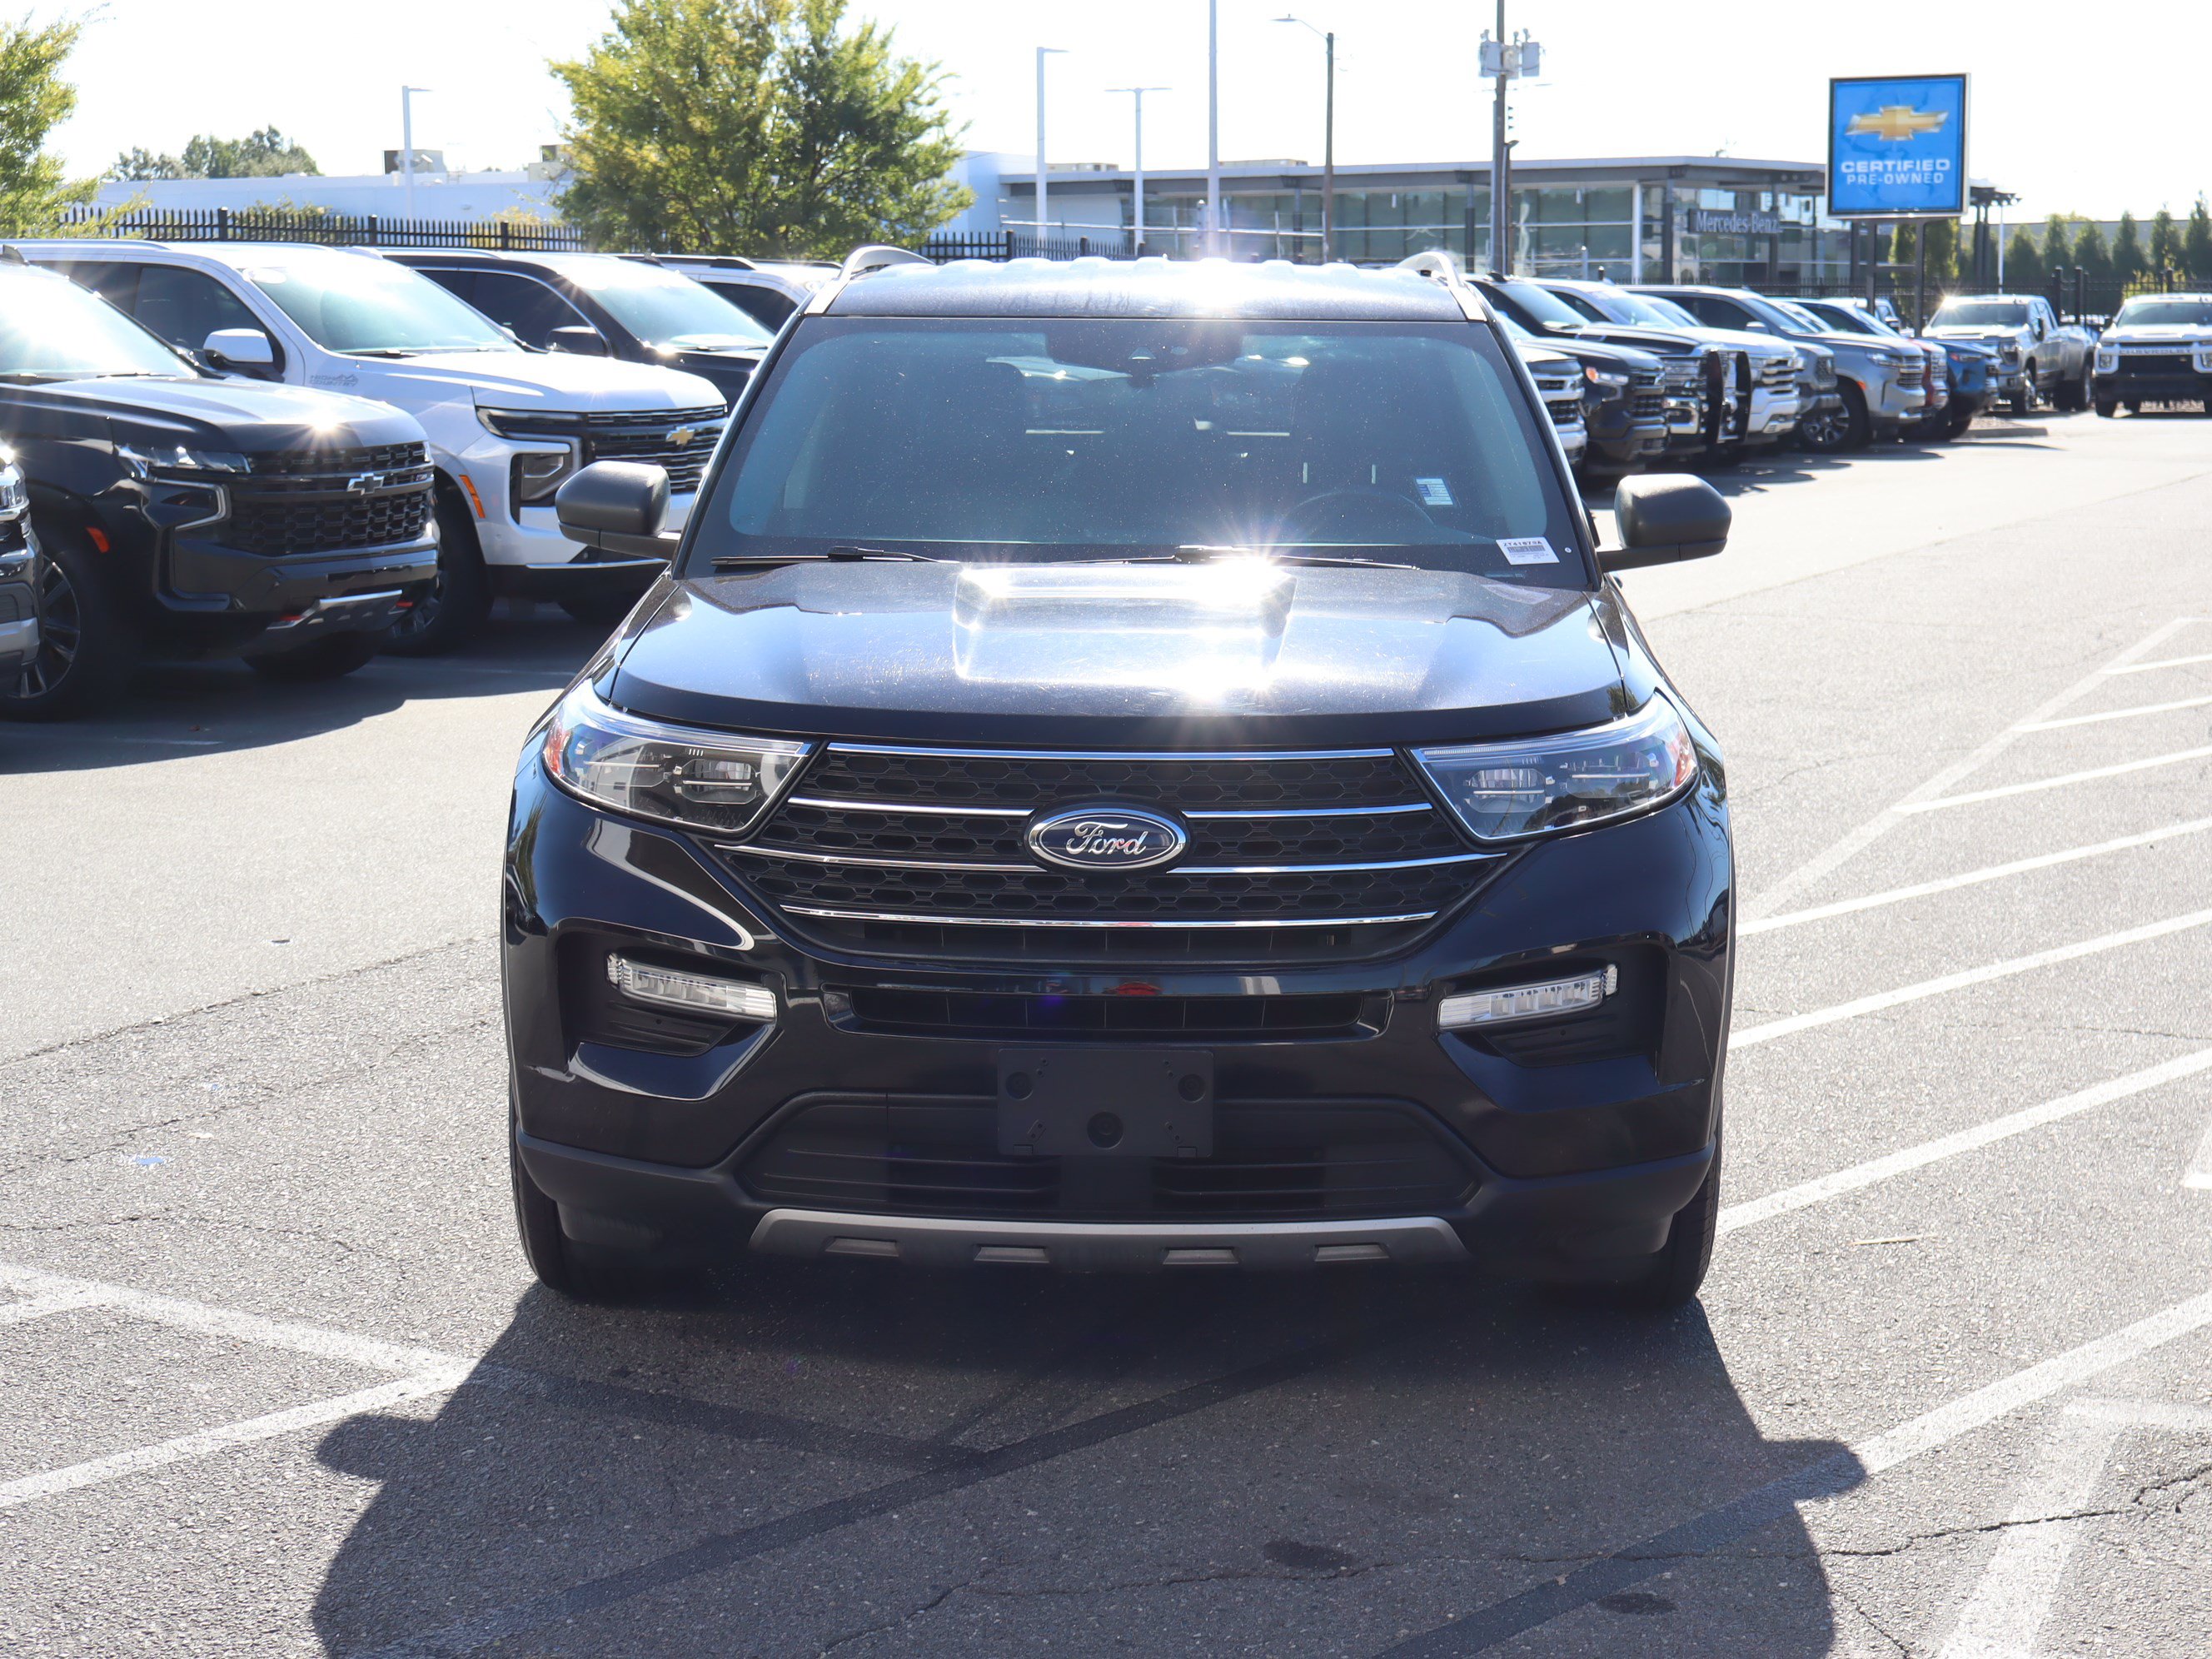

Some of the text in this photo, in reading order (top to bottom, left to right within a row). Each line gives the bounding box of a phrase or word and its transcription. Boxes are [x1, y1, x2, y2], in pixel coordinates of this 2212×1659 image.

[1841, 159, 1950, 173] CERTIFIED
[1847, 172, 1944, 185] PRE-OWNED
[1696, 211, 1779, 233] Mercedes-Benz
[1066, 821, 1148, 854] Ford
